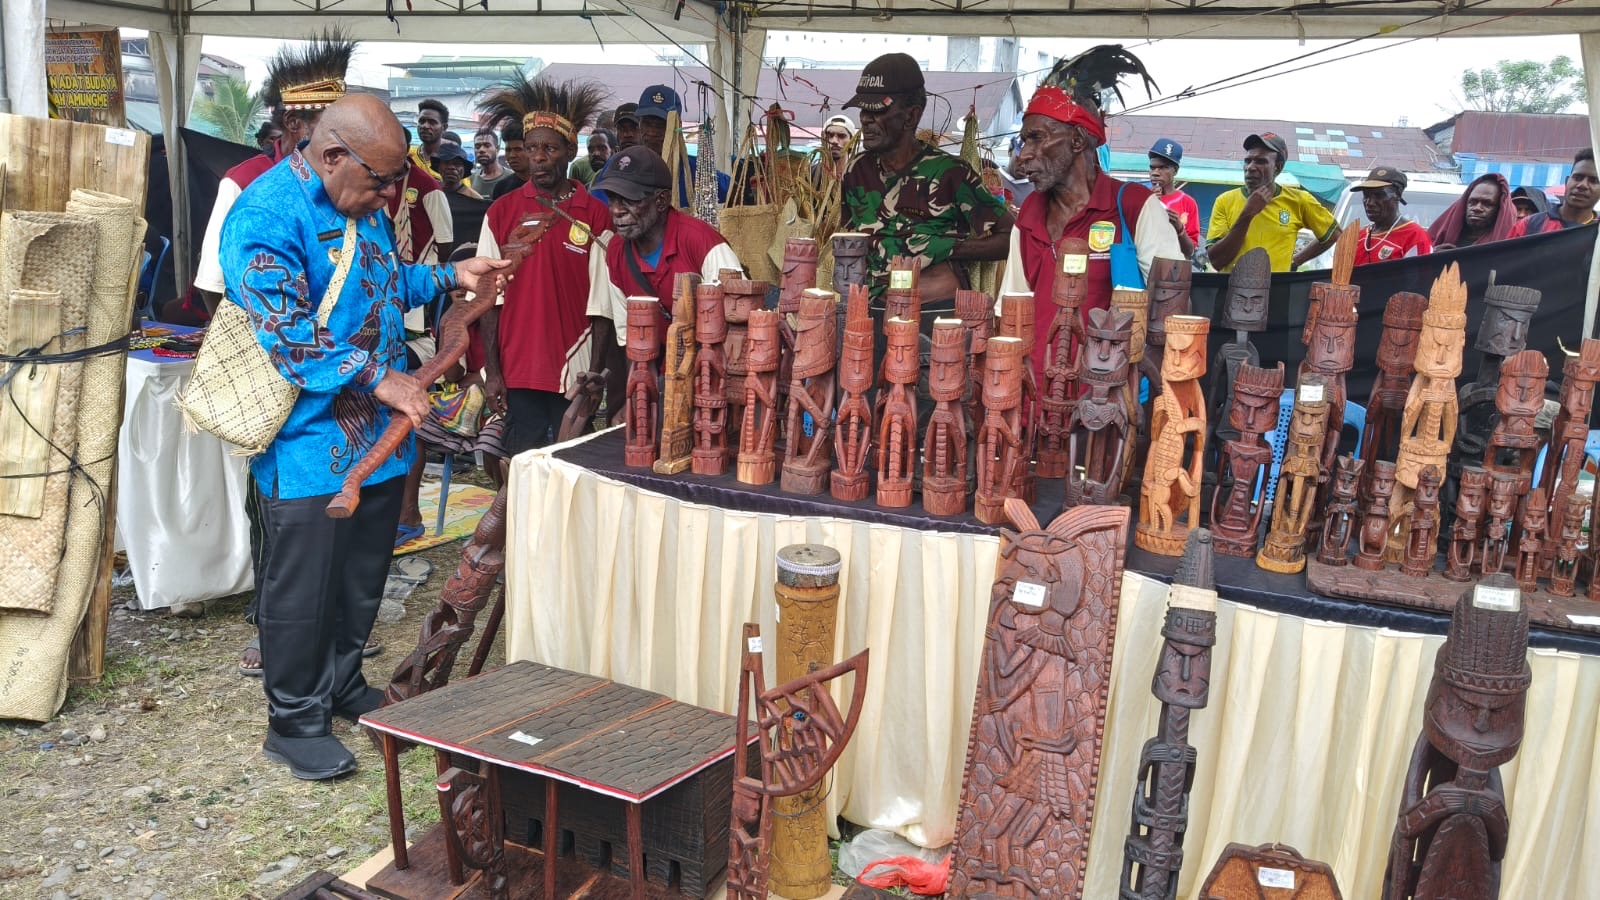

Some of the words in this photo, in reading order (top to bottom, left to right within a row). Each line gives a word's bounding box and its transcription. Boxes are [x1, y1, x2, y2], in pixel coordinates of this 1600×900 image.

[59, 75, 84, 90] ADAT
[85, 75, 118, 91] BUDAYA
[68, 93, 108, 107] AMUNGME
